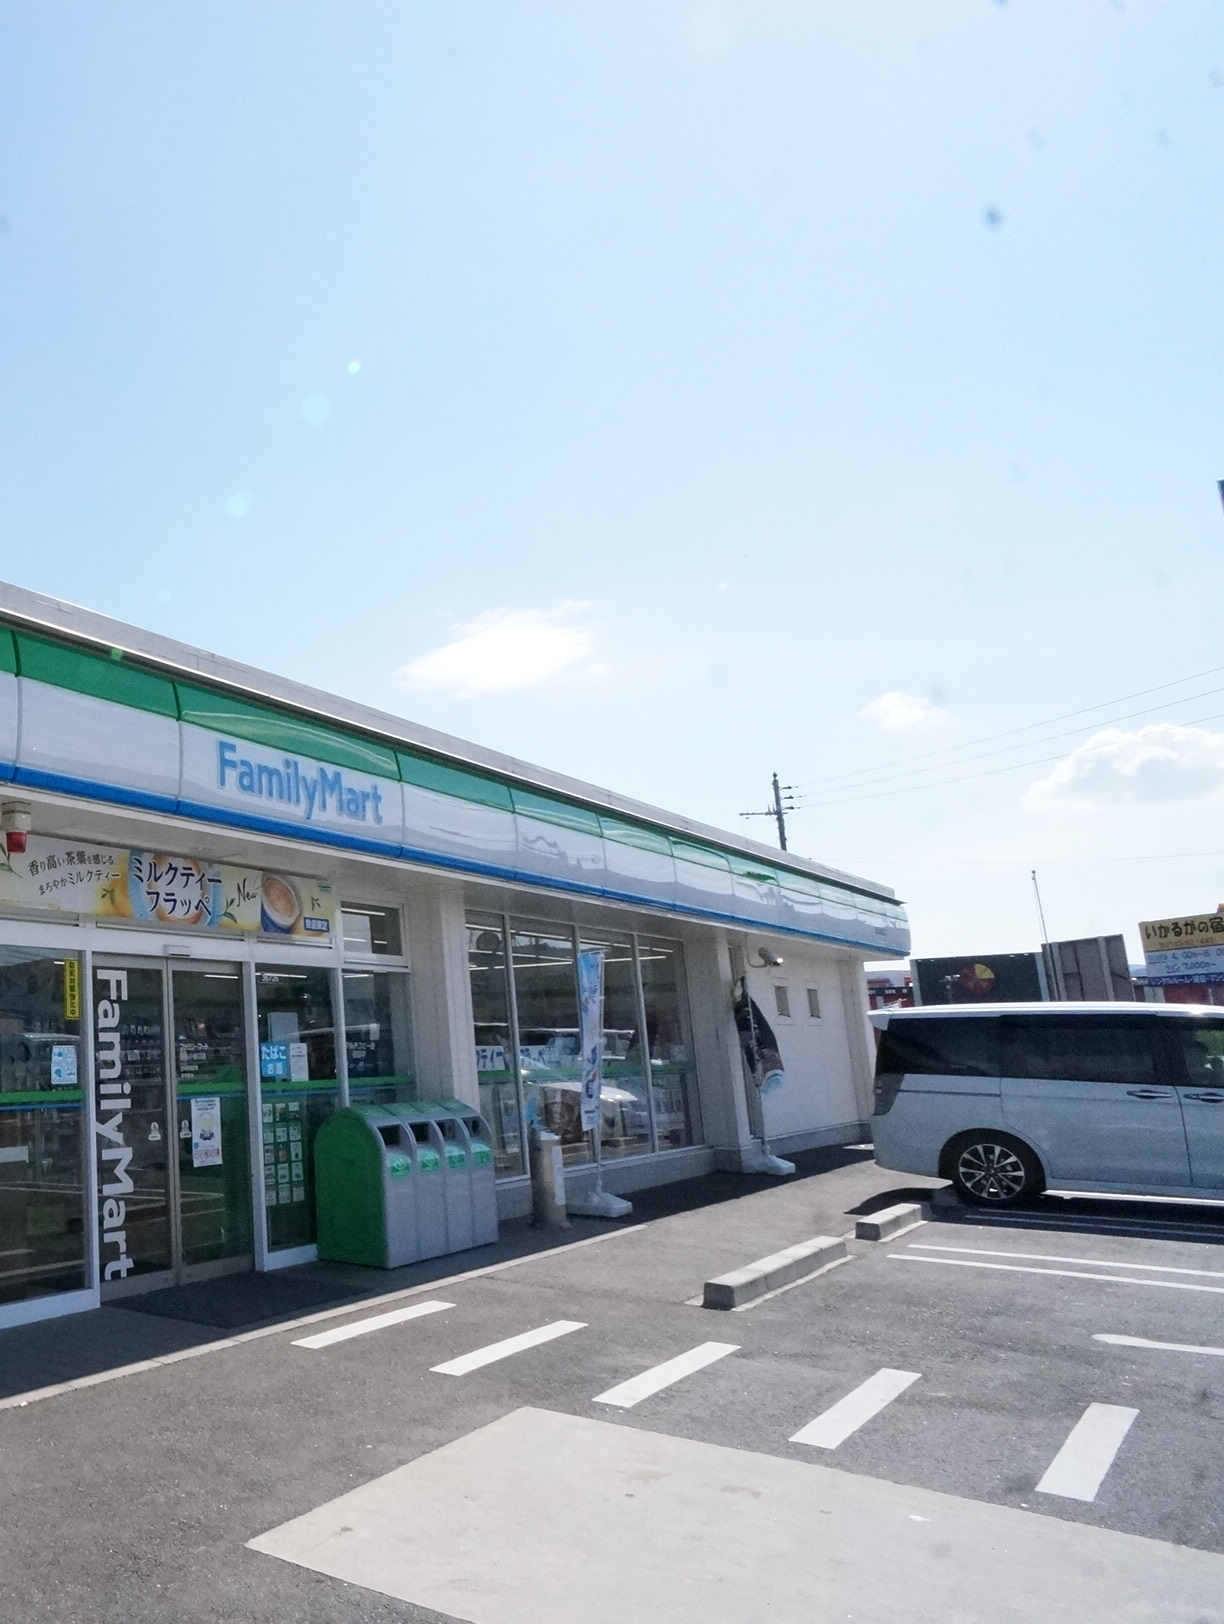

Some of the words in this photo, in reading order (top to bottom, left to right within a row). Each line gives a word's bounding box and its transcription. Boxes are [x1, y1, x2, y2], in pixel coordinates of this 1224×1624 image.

[218, 740, 383, 825] FamilyMart
[38, 870, 120, 895] まろやかミルクティー
[132, 857, 222, 891] ミルクティー
[146, 890, 212, 916] フラッペ
[261, 1045, 287, 1060] たばこ
[96, 969, 134, 1281] FamilyMart
